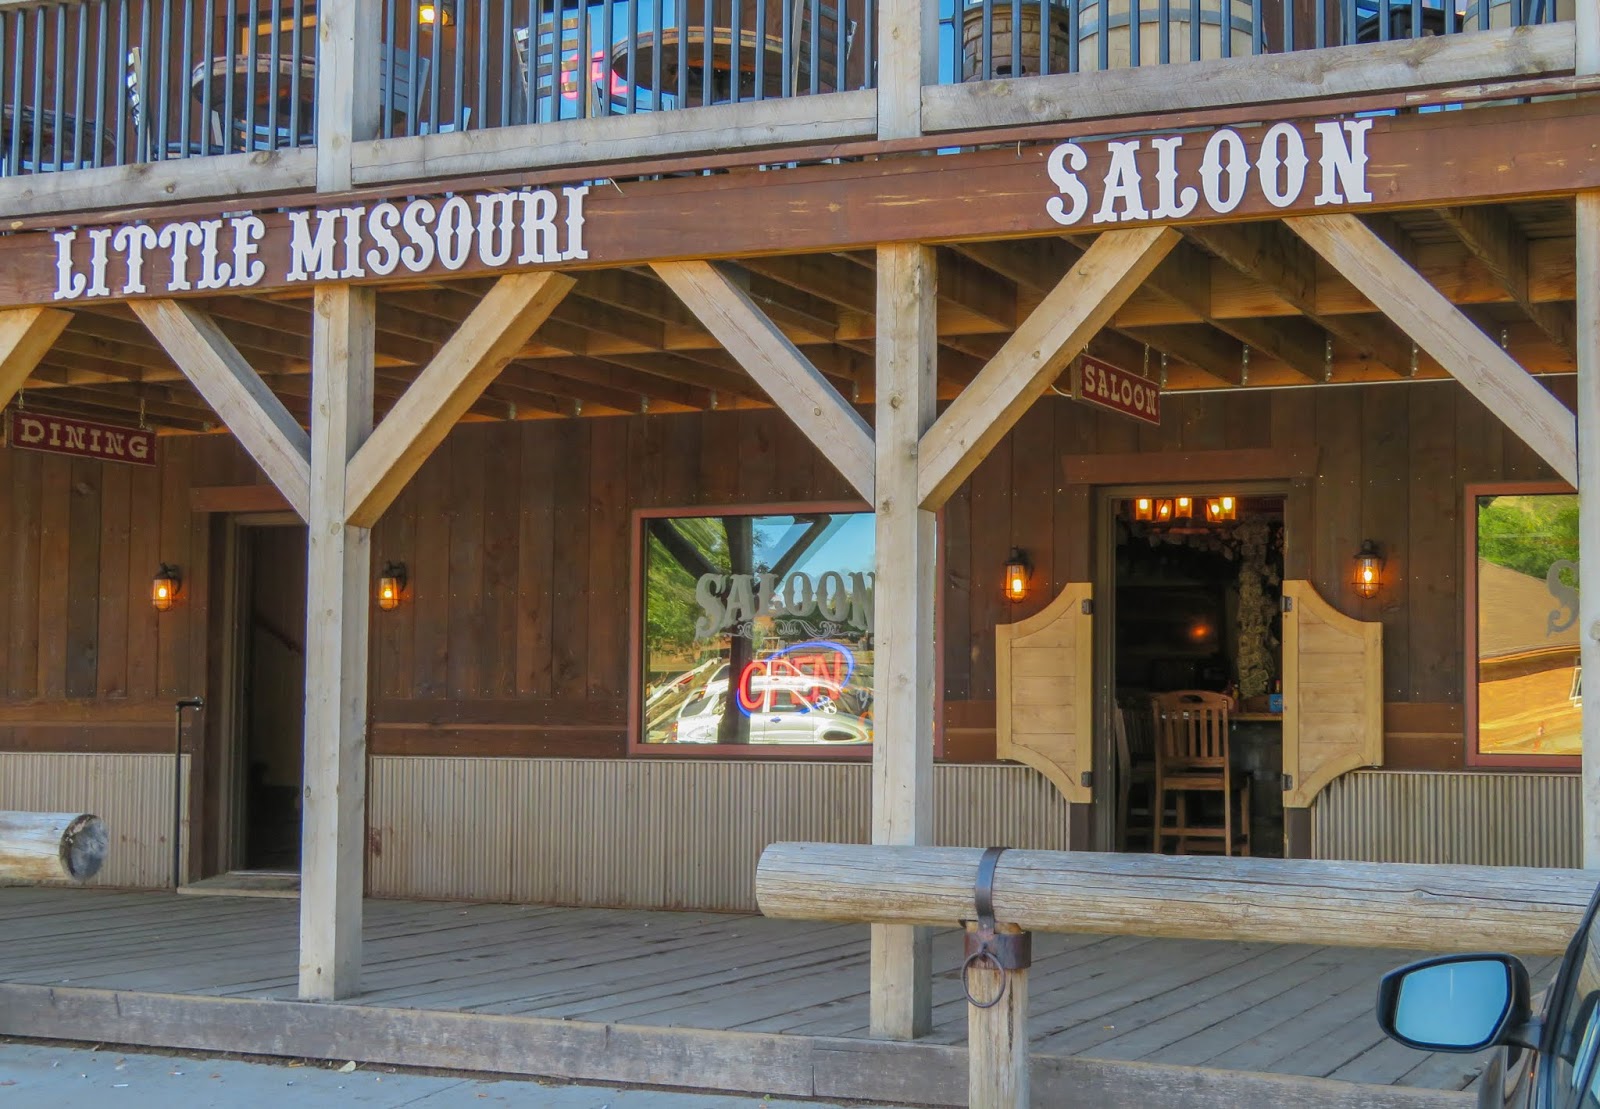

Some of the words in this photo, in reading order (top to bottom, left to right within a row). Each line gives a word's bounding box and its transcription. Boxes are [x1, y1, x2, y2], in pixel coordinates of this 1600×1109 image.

[53, 216, 266, 300] LITTLE
[287, 185, 590, 283] MISSOURI
[1045, 118, 1375, 226] SALOON
[1084, 363, 1158, 416] SALOON
[20, 418, 149, 459] DINING
[738, 651, 843, 710] OPEN
